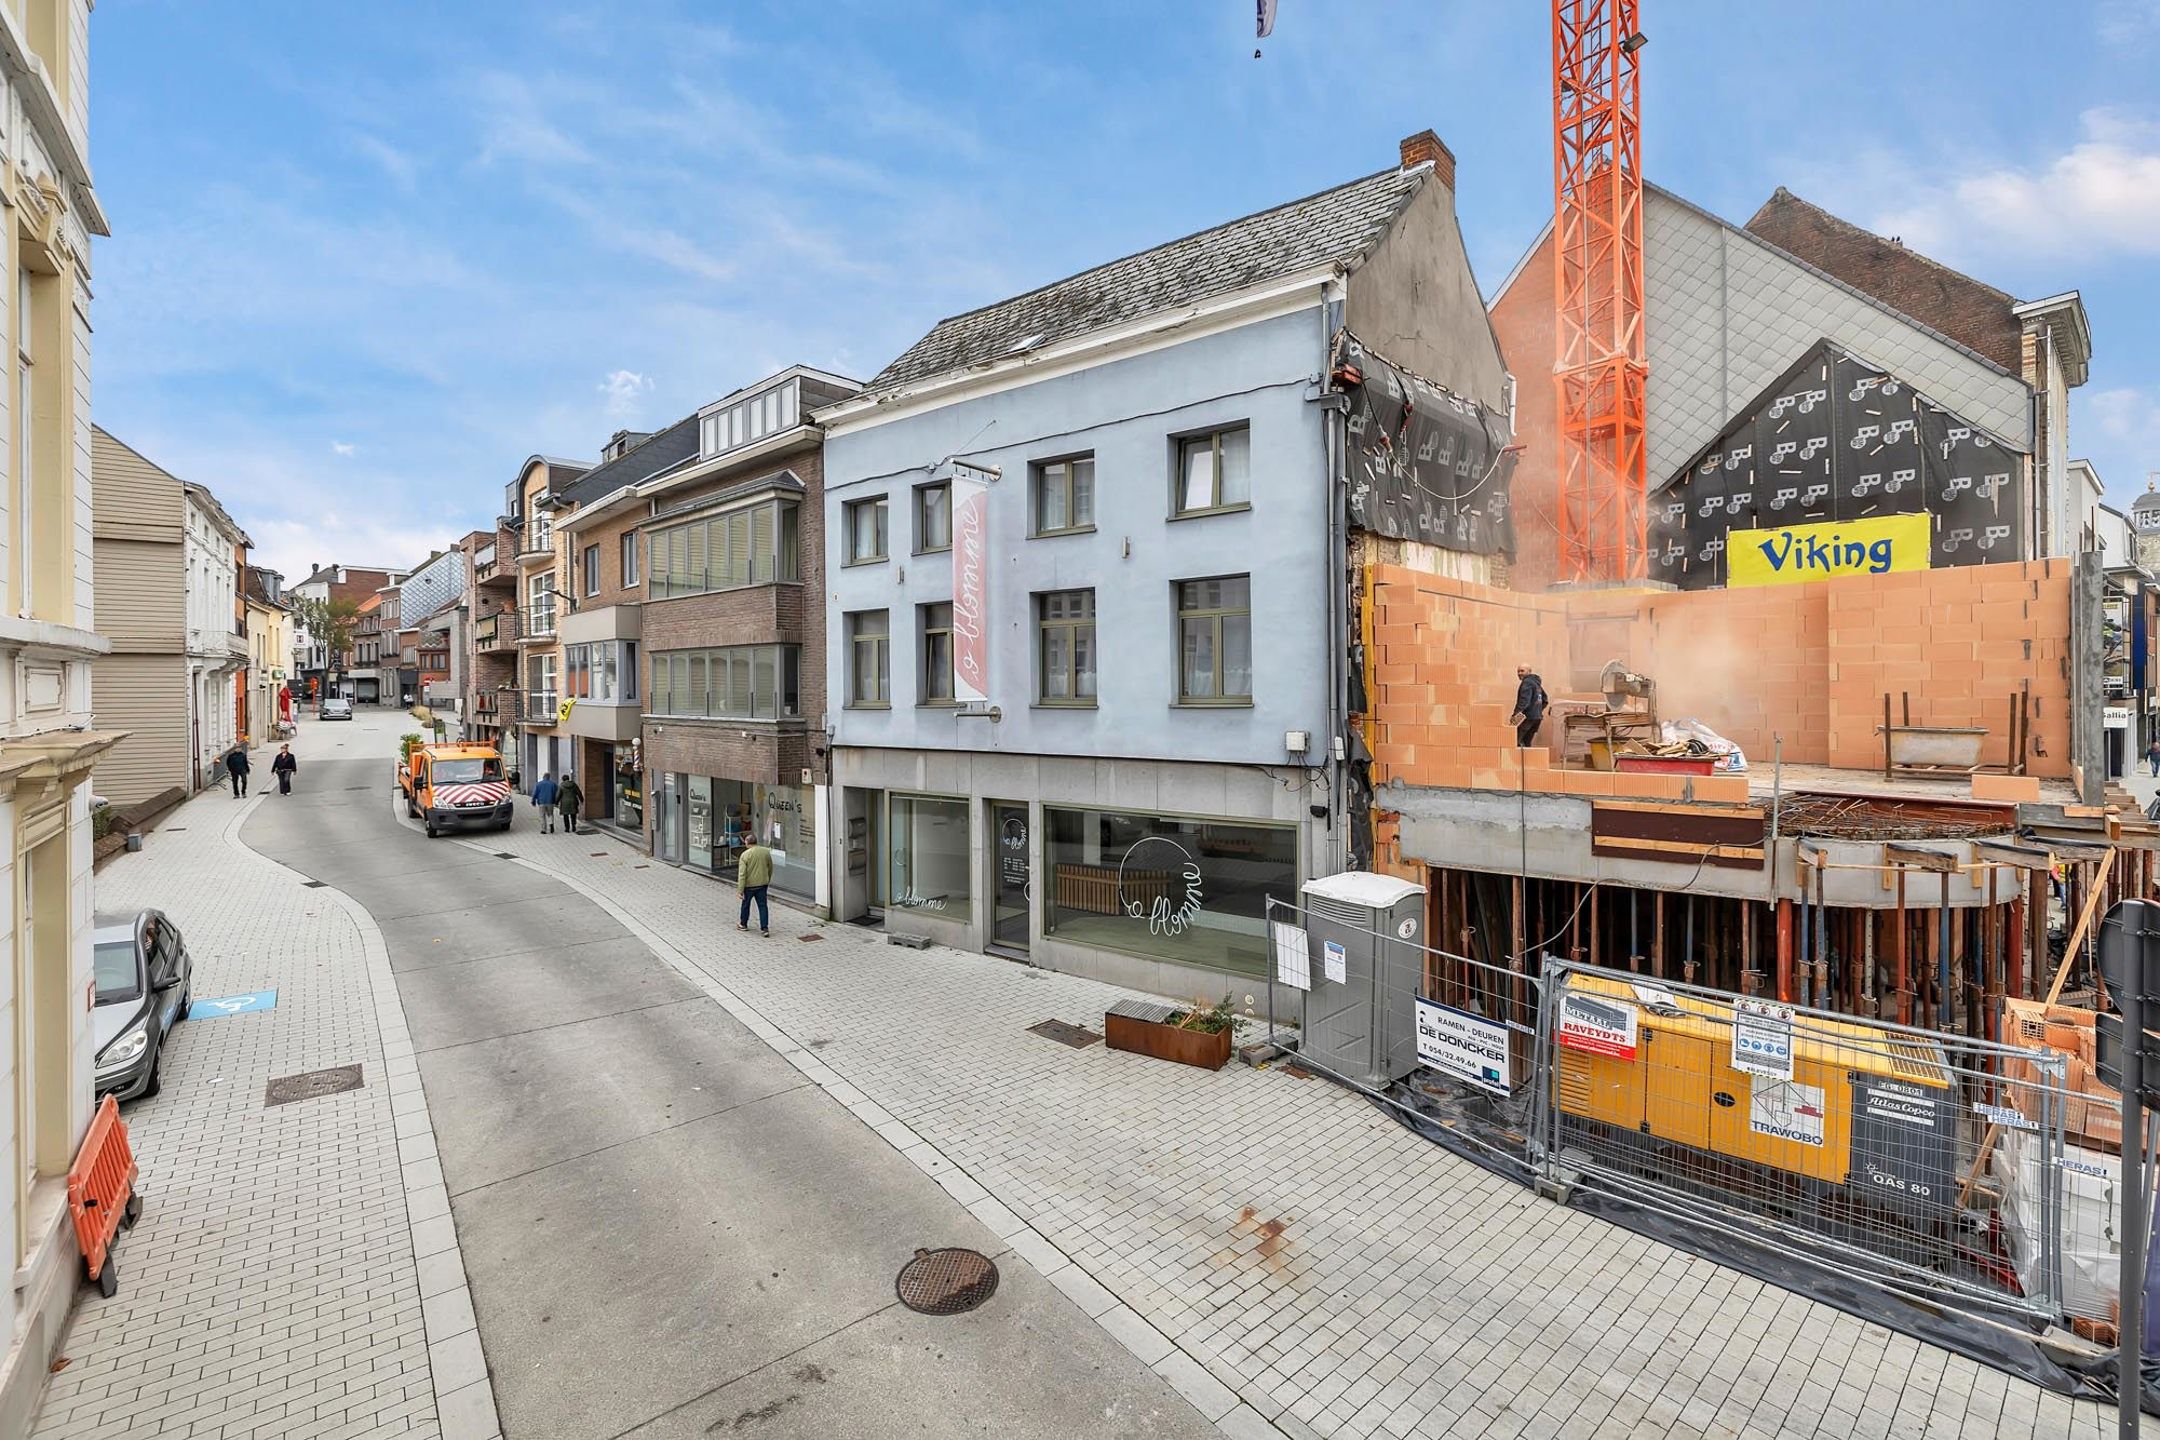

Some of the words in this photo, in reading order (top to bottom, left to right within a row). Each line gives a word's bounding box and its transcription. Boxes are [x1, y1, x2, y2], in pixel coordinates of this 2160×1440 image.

[1757, 532, 1893, 574] Viking
[1438, 1016, 1466, 1032] RAMEN
[1472, 1027, 1504, 1045] DEUREN
[1564, 1022, 1626, 1042] RAVEYDTS
[1420, 1025, 1437, 1039] DE
[1438, 1032, 1505, 1063] DONCKER
[1867, 1096, 1901, 1110] Atlas
[1901, 1103, 1935, 1117] Copco
[1752, 1120, 1823, 1146] TRAWOBO
[1911, 1183, 1930, 1196] 80
